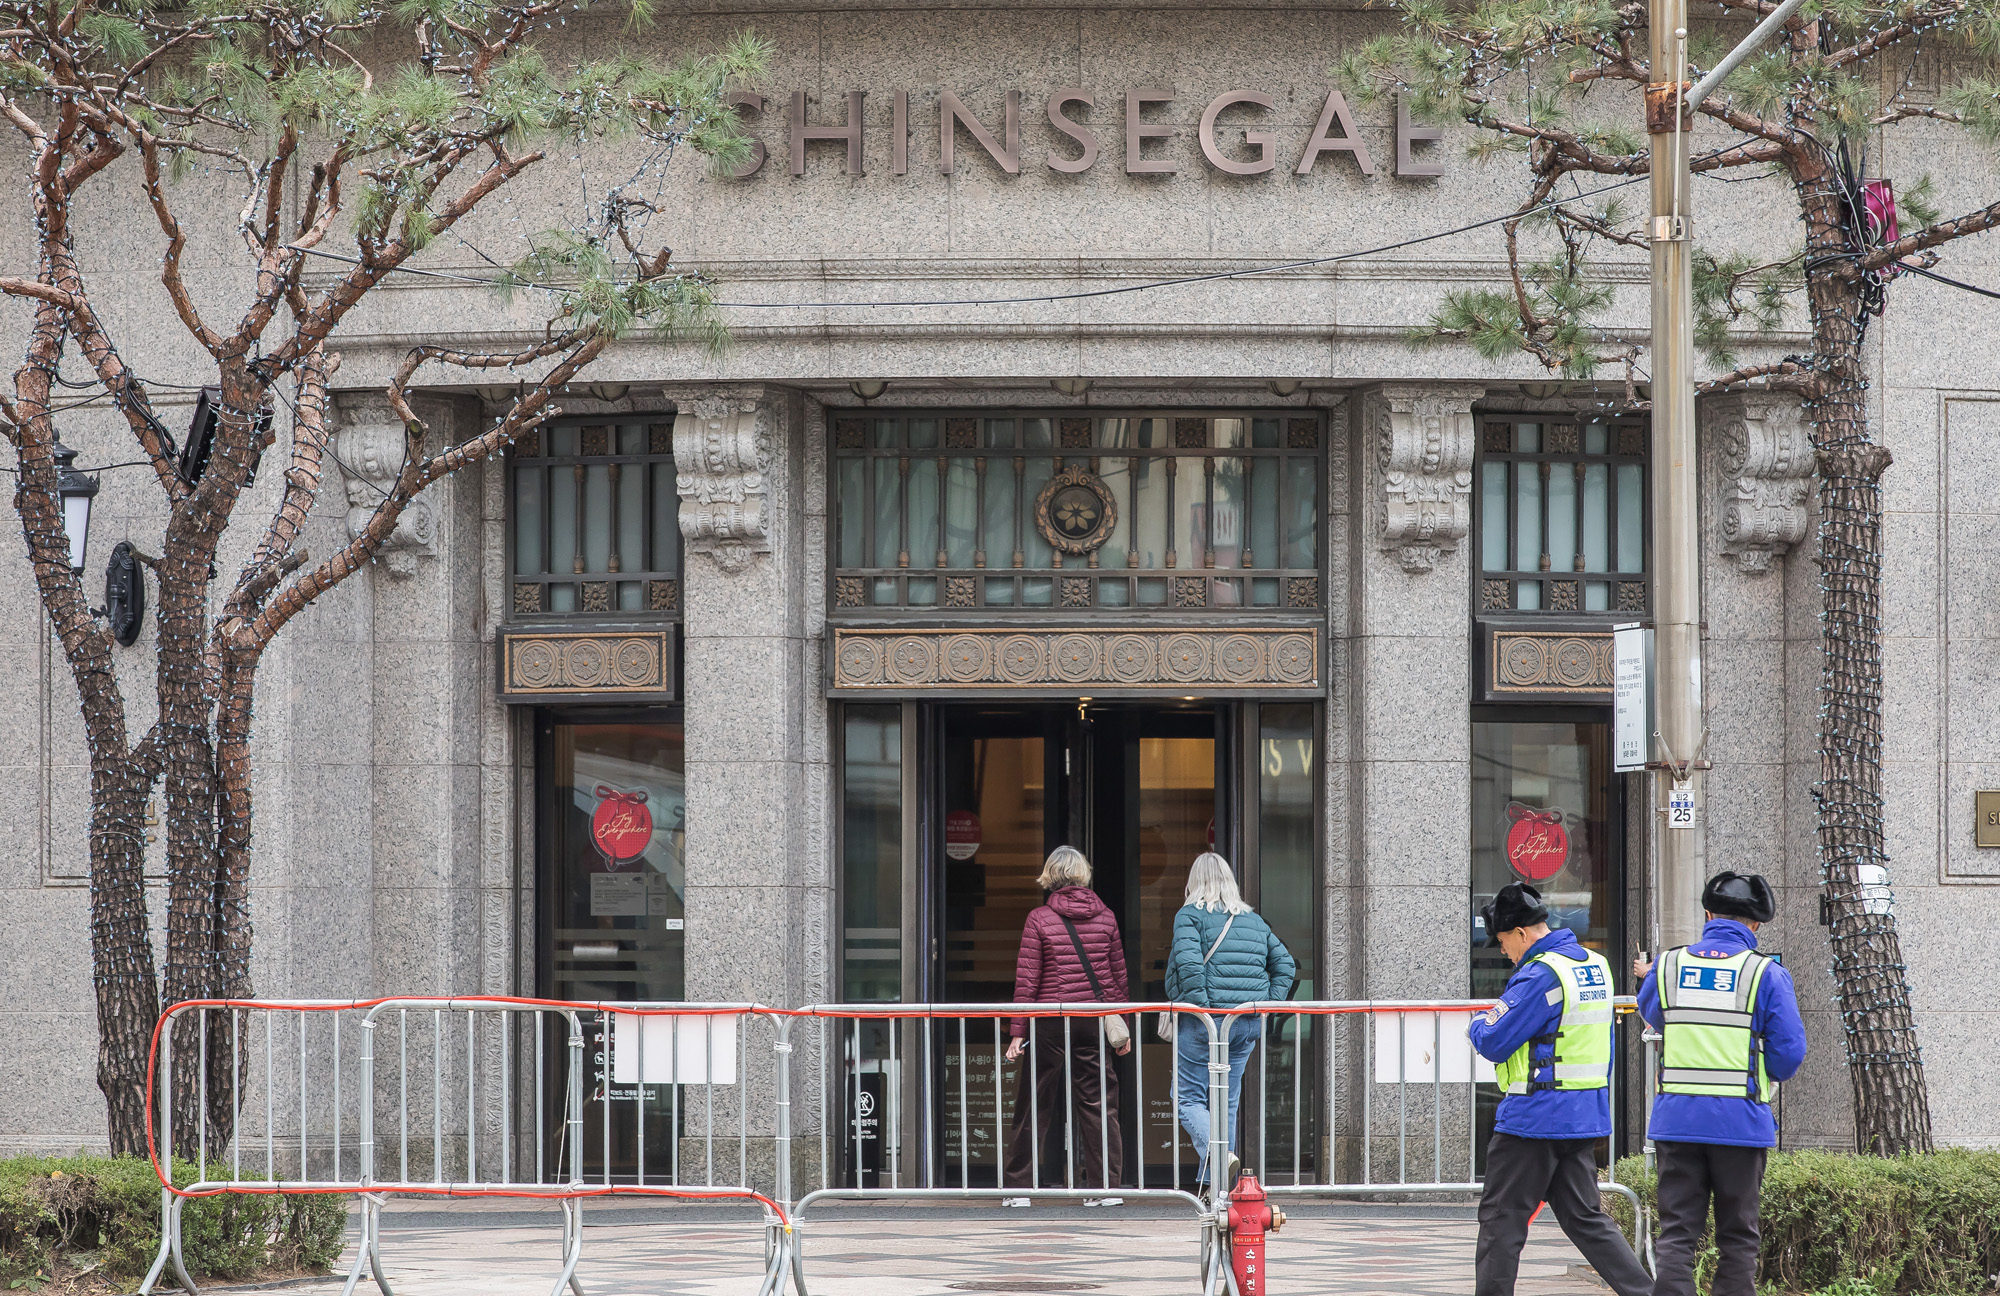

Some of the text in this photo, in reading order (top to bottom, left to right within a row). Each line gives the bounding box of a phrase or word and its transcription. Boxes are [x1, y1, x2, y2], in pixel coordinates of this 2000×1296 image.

[611, 812, 633, 829] Joy
[1673, 808, 1691, 822] 25
[1988, 811, 2000, 825] S
[596, 823, 648, 841] Everywhere
[1526, 832, 1548, 849] Joy
[1511, 843, 1564, 861] Everywhere
[1574, 966, 1604, 985] 모범
[1682, 967, 1733, 991] 교통
